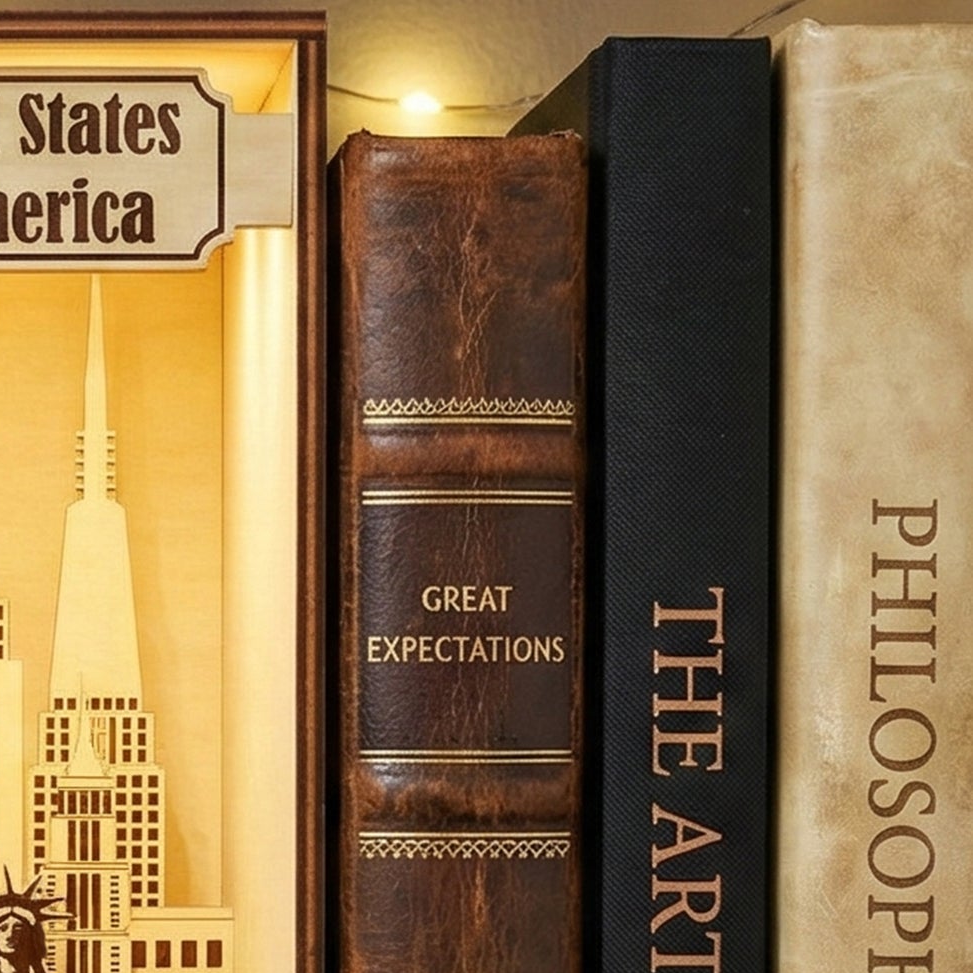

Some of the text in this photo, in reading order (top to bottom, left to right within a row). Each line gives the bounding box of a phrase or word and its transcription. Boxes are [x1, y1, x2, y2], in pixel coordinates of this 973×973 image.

[18, 92, 181, 155] States
[422, 585, 513, 612] GREAT
[367, 635, 565, 663] EXPECTATIONS
[652, 587, 725, 776] THE
